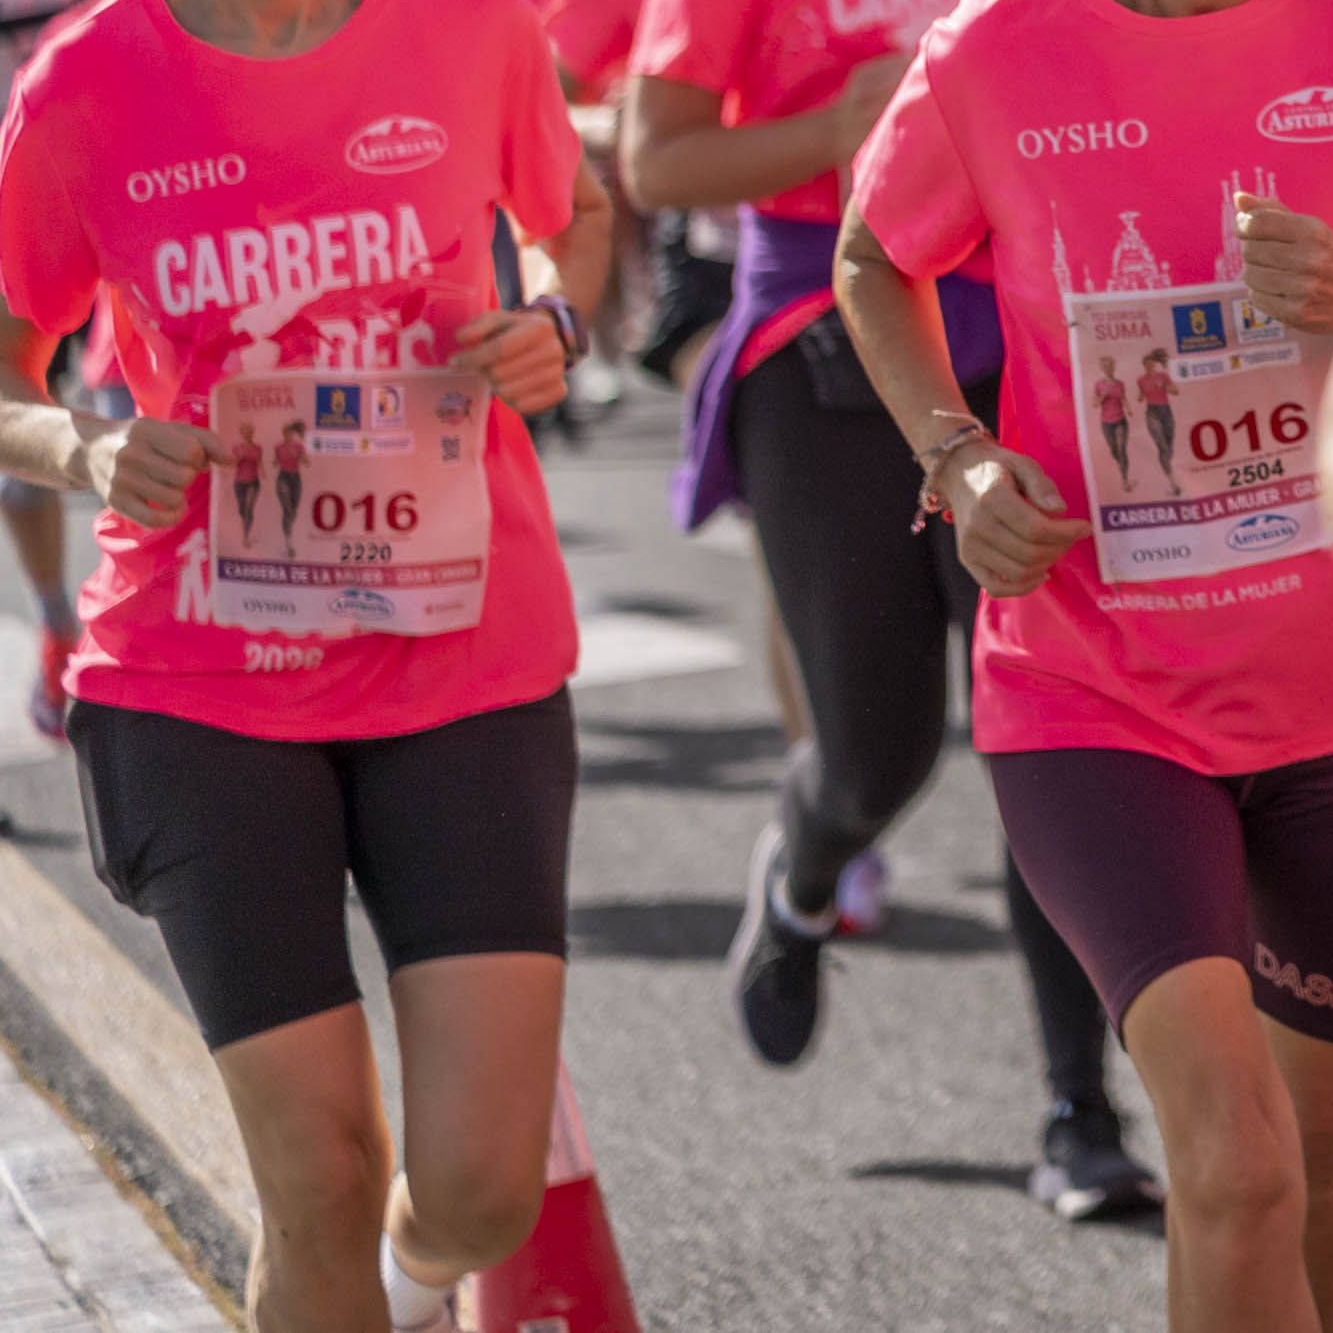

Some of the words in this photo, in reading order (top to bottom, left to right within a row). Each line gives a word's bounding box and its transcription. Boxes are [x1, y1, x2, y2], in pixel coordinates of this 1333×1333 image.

[1017, 119, 1149, 159] OYSHO
[127, 153, 247, 203] OYSHO
[156, 206, 434, 317] CARRERA
[1095, 321, 1152, 341] SUMA
[1190, 401, 1310, 463] 016
[1228, 458, 1286, 488] 2504
[311, 490, 419, 534] 016
[1108, 507, 1179, 528] CARRERA
[1180, 505, 1201, 523] DE
[1203, 499, 1225, 518] LA
[1226, 487, 1281, 514] MUJER
[339, 541, 393, 565] 2220
[1131, 544, 1193, 564] OYSHO
[1095, 590, 1181, 613] CARRERA
[1181, 590, 1210, 610] DE
[1211, 586, 1237, 607] LA
[1239, 574, 1303, 601] MUJER
